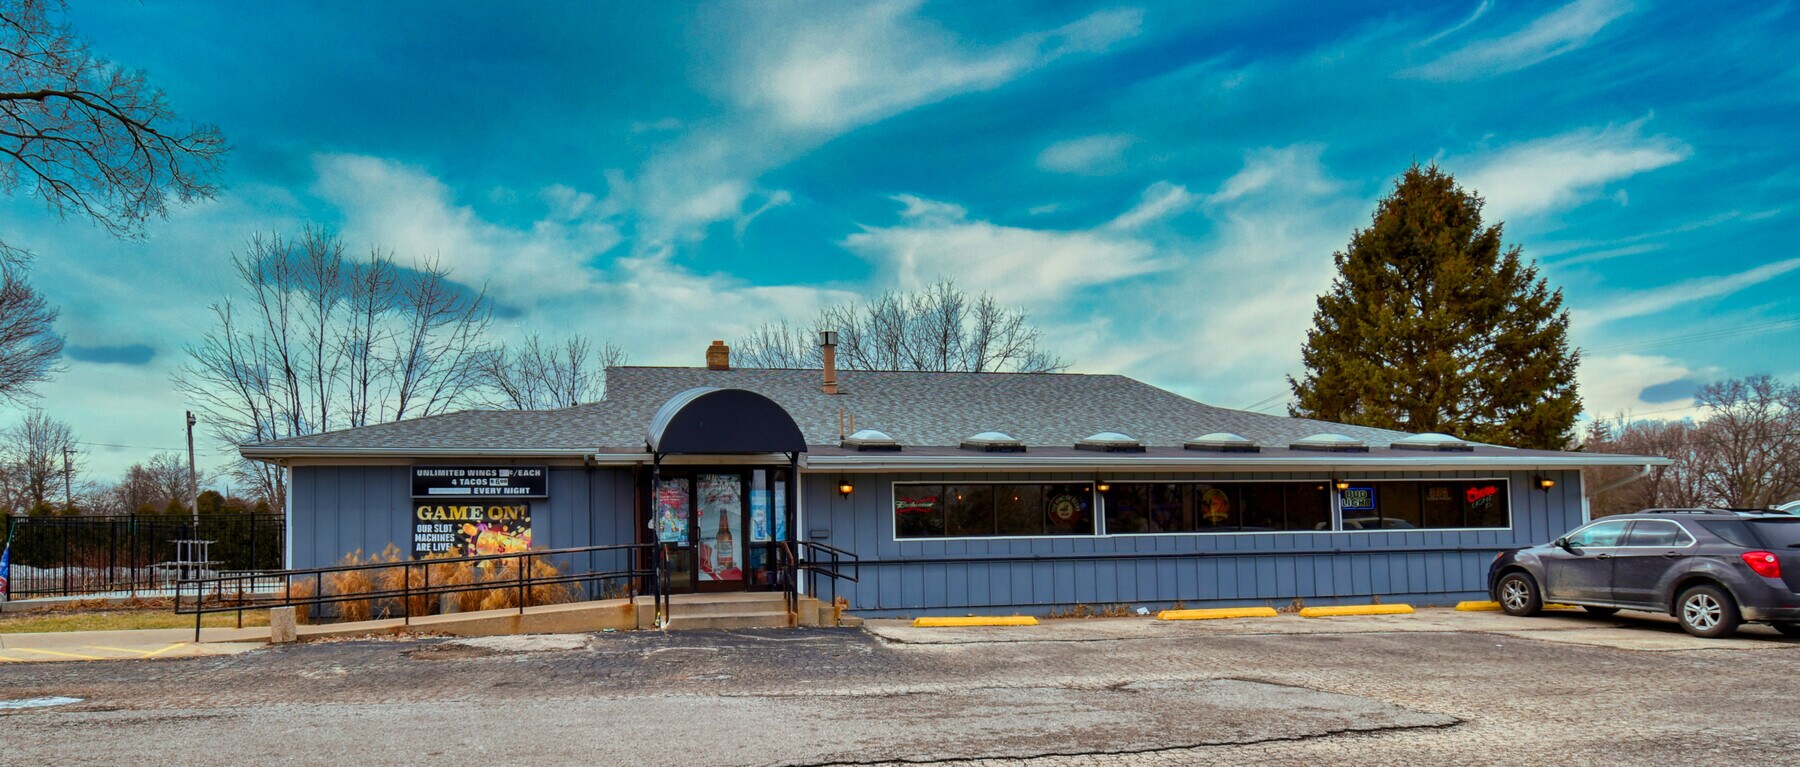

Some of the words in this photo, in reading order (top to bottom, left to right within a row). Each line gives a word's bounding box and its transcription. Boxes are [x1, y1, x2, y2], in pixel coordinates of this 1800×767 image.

[416, 469, 465, 477] UNLIMITED
[467, 469, 497, 477] WINGS
[1344, 489, 1368, 499] BUD
[416, 505, 484, 520] GAME
[488, 505, 527, 520] ON!
[416, 524, 433, 533] OUR
[434, 524, 453, 533] SLOT
[415, 533, 456, 542] MACHINES
[416, 543, 432, 552] ARE
